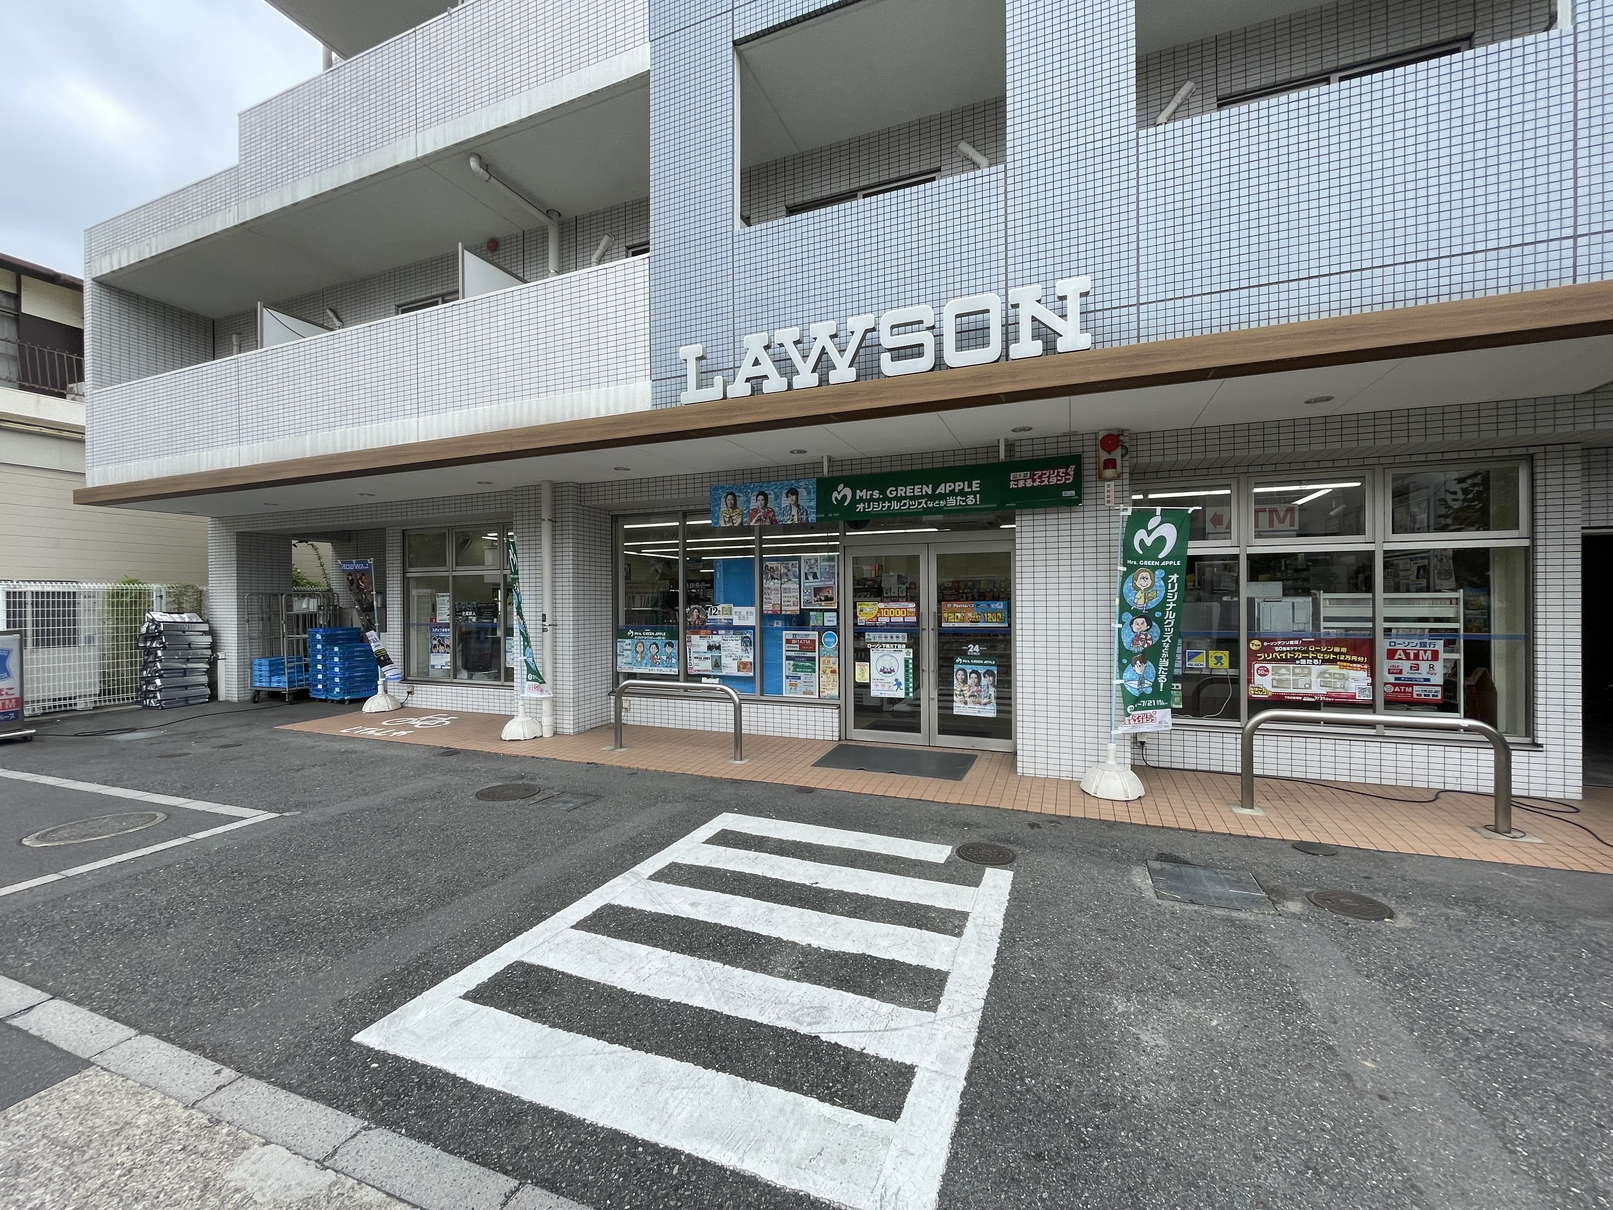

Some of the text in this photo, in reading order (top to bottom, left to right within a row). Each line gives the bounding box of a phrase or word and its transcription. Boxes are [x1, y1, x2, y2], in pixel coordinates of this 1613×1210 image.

[679, 275, 1092, 405] LAWSON
[856, 480, 981, 500] Mrs. GREEN APPLE
[1394, 650, 1432, 660] ATM
